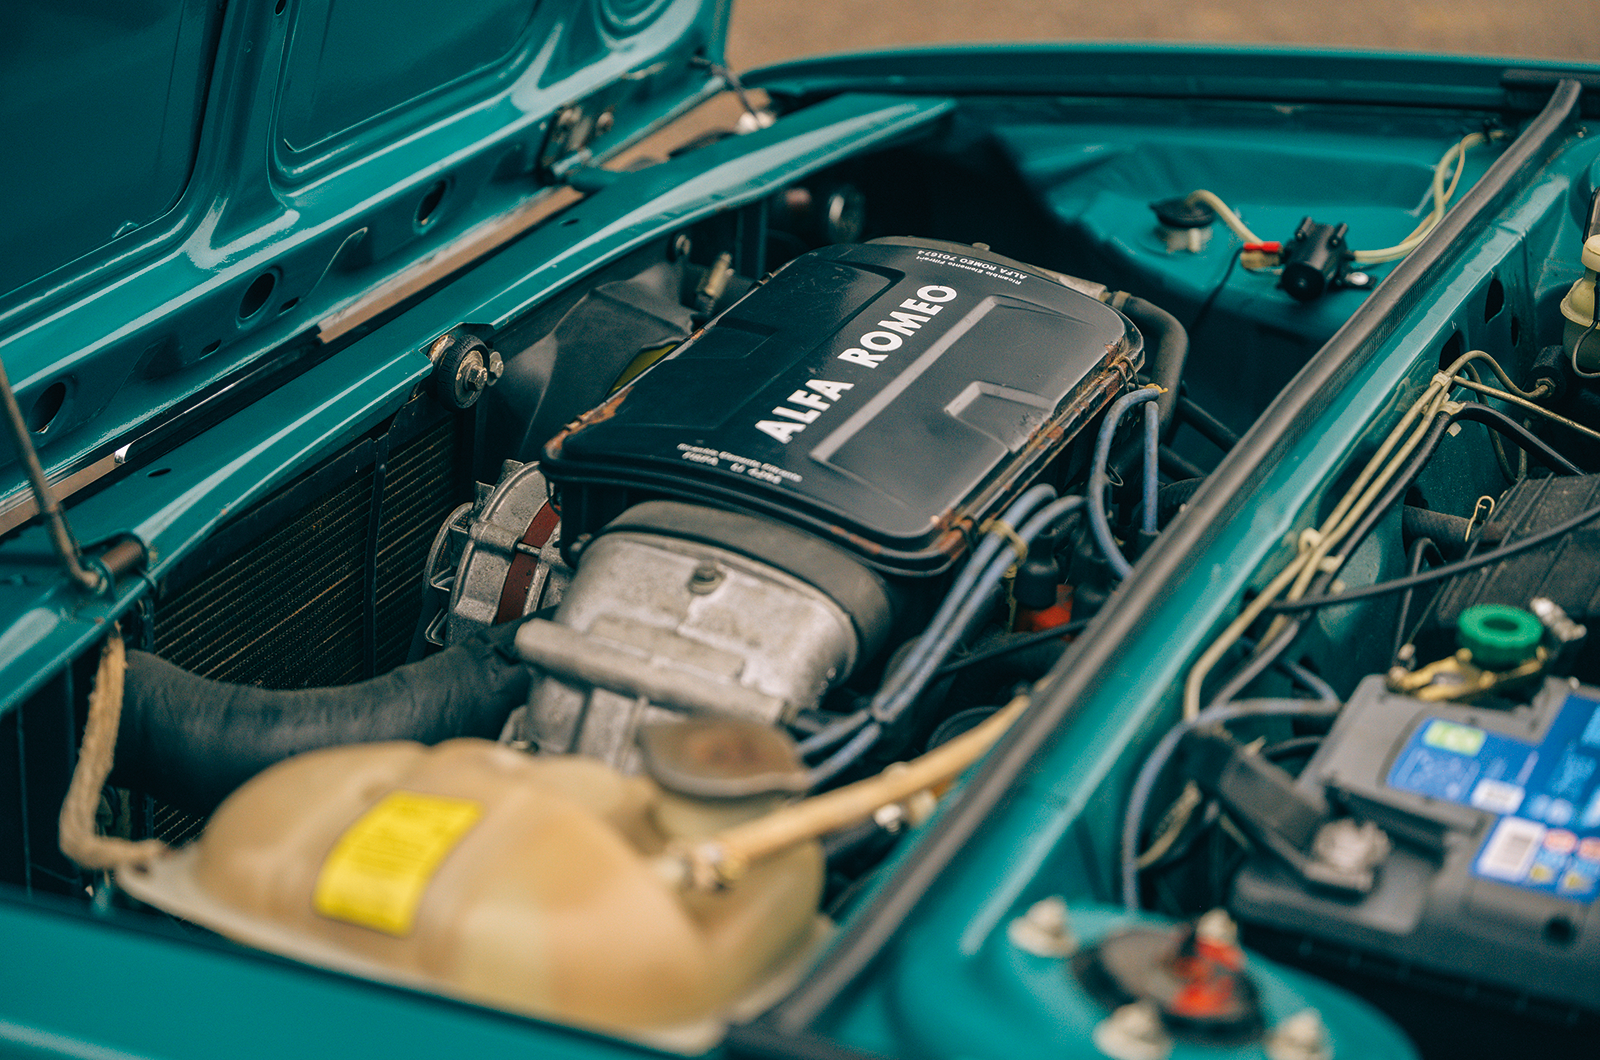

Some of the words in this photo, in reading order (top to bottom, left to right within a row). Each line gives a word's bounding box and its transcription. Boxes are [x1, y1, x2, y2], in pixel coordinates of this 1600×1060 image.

[947, 261, 984, 274] Elemento
[959, 257, 997, 272] ROMEO
[985, 270, 1022, 286] Ricambio
[999, 267, 1028, 280] ALFA
[754, 378, 855, 445] ALFA
[837, 284, 958, 370] ROMEO
